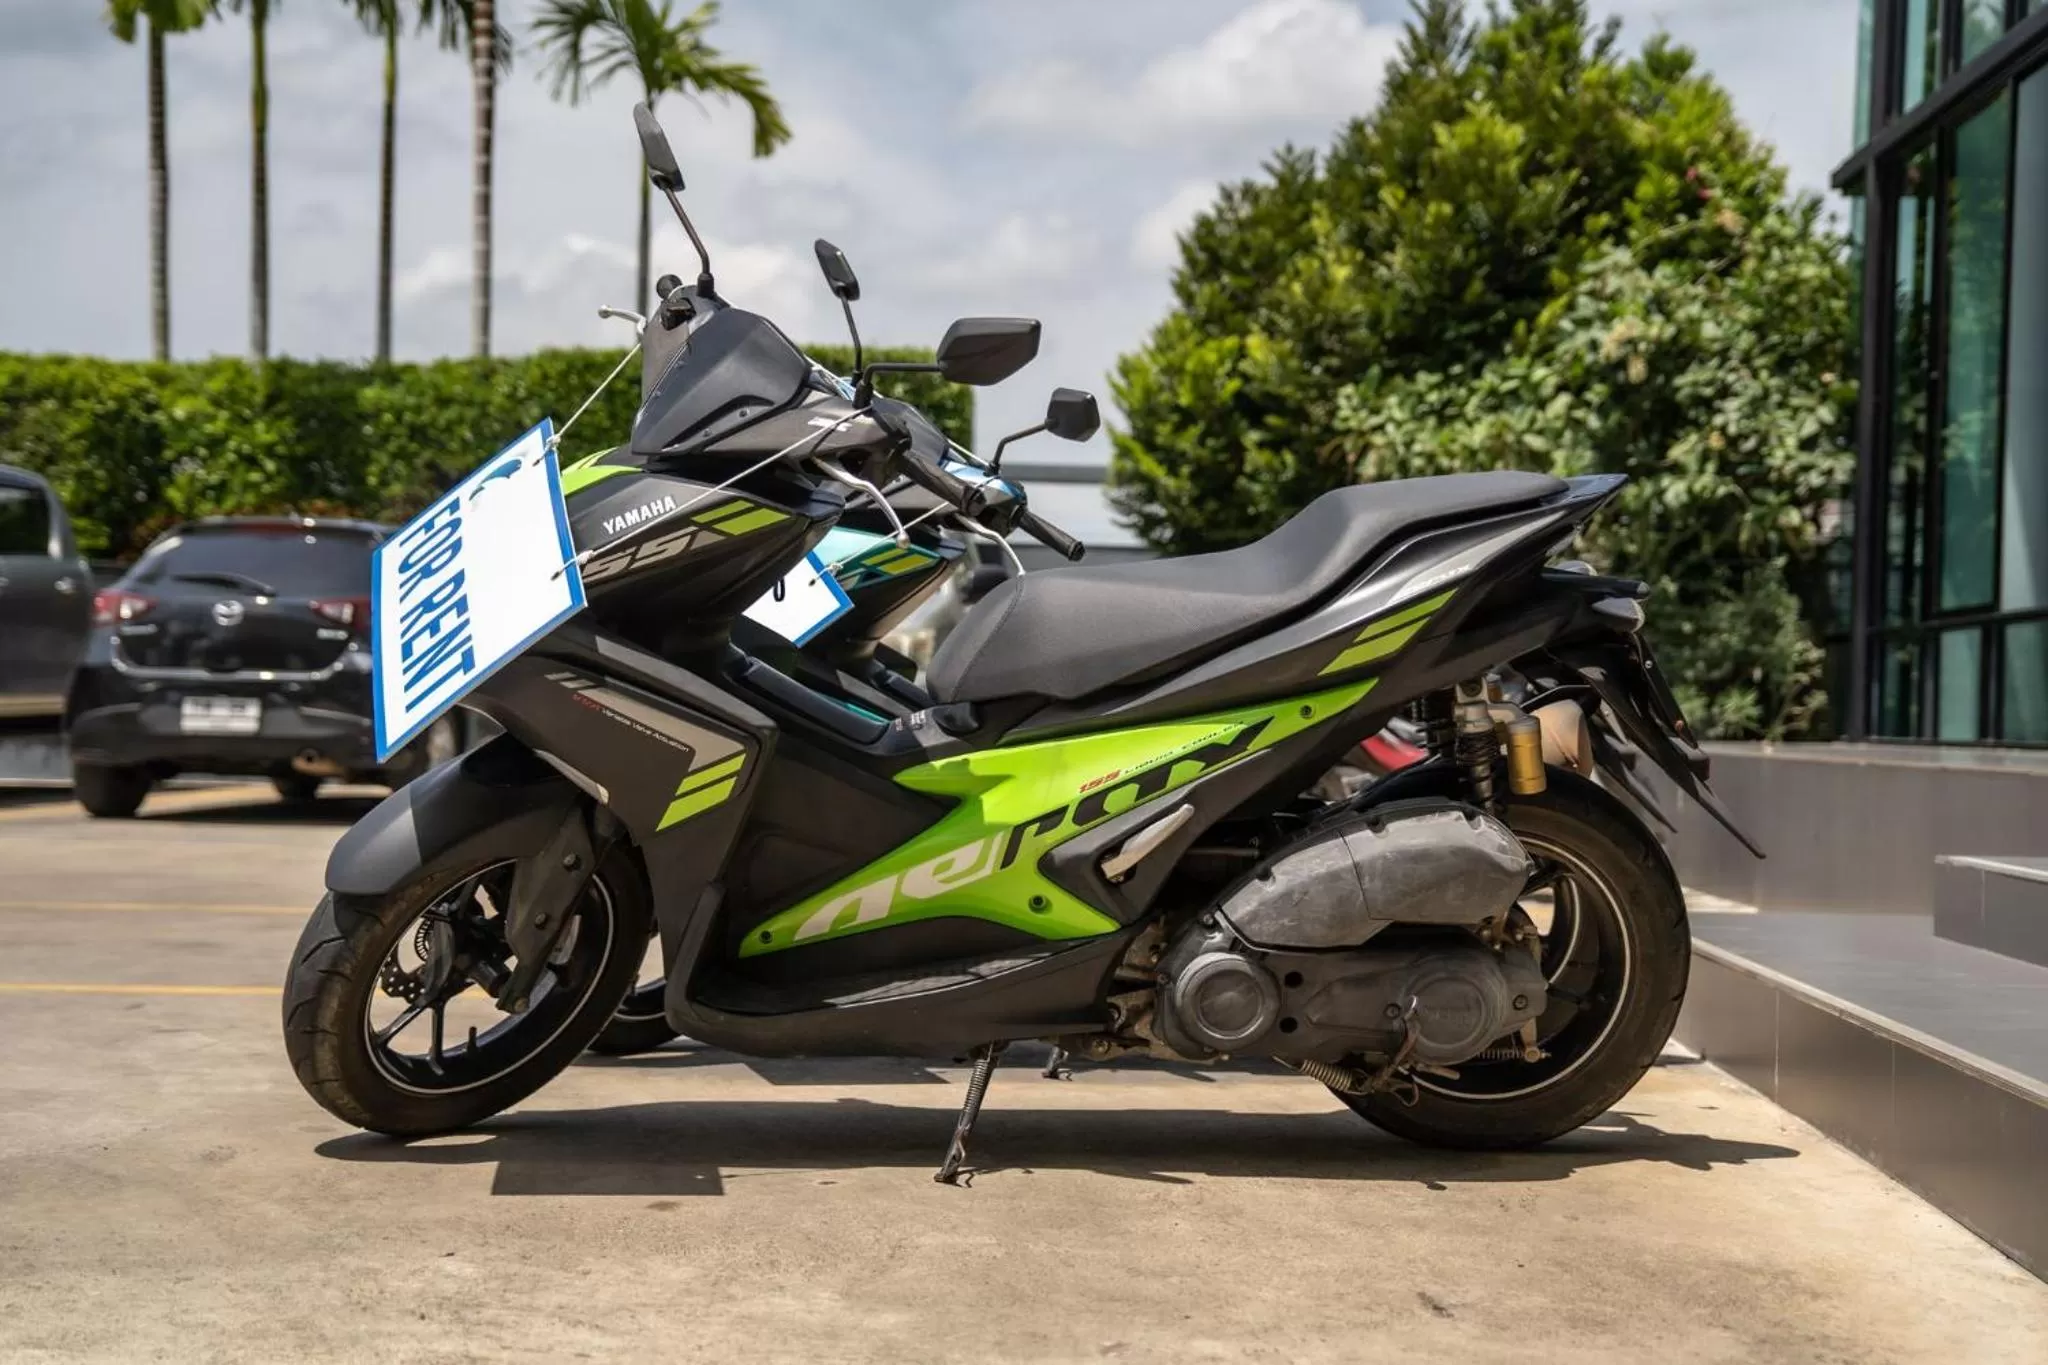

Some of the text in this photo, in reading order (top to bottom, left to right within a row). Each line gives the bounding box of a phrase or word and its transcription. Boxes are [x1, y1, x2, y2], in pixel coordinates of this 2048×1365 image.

[603, 495, 677, 536] YAMAHA
[398, 496, 476, 714] FOR RENT
[1079, 769, 1121, 792] 155
